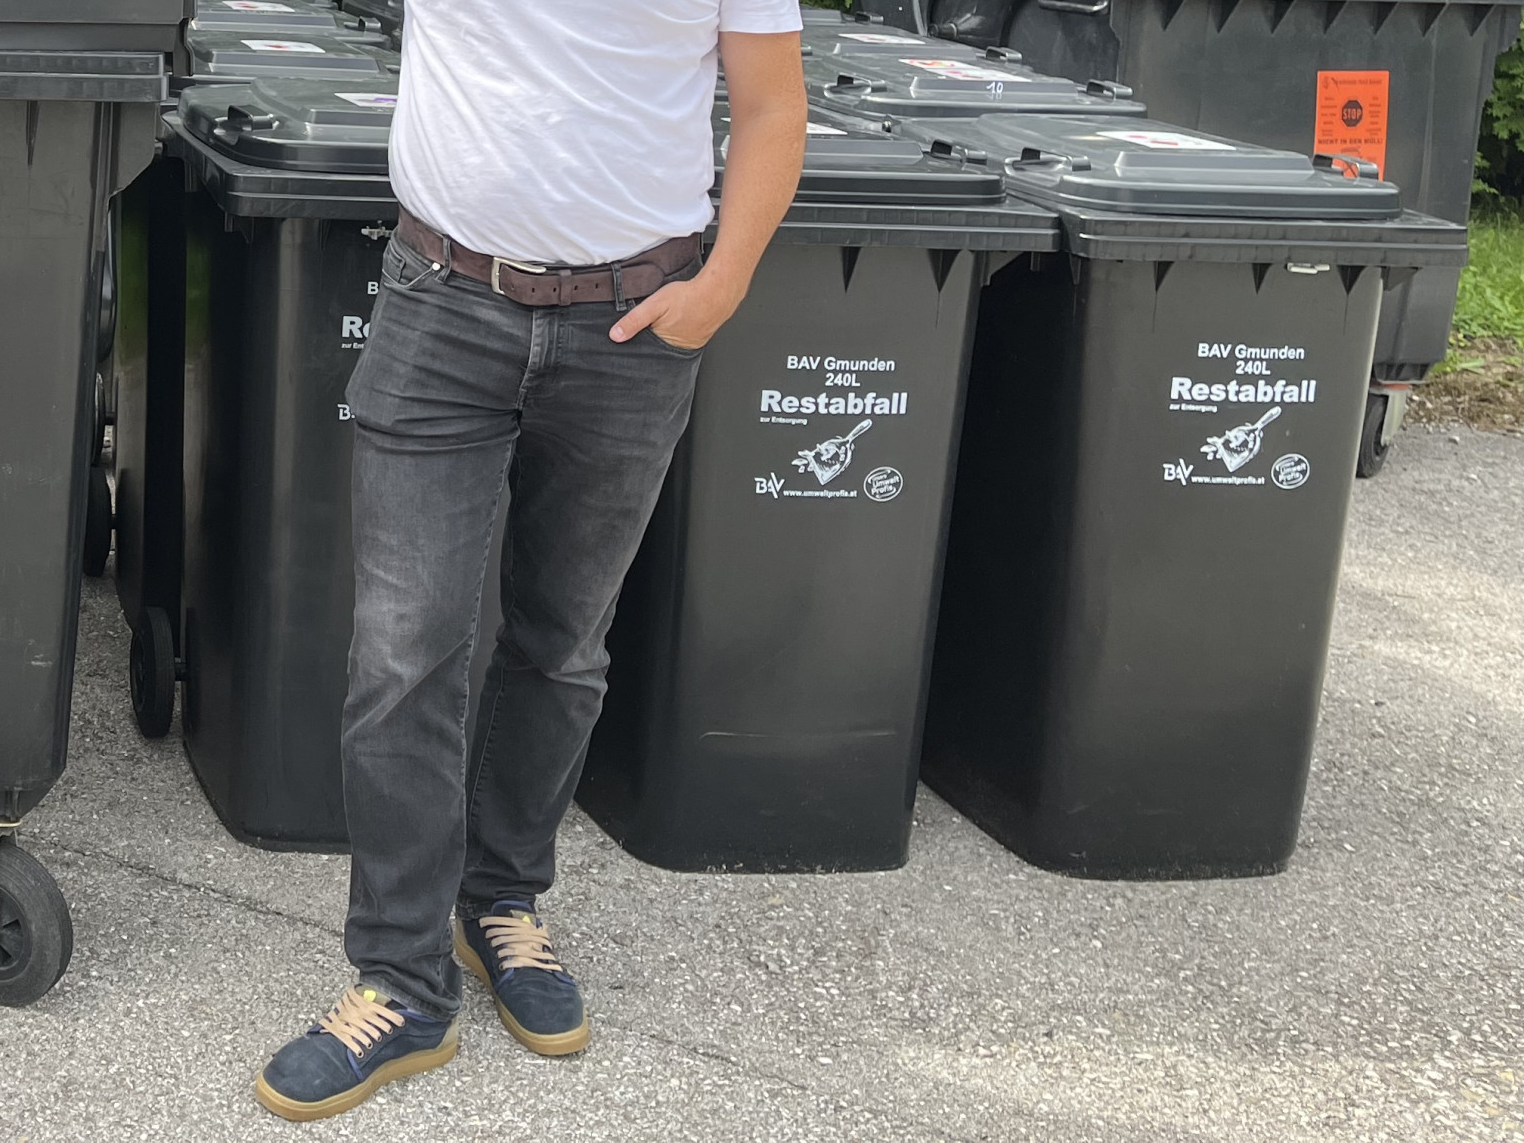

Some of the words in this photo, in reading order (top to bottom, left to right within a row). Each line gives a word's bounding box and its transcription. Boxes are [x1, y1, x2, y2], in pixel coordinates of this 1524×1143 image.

[1342, 108, 1362, 120] STOP
[1197, 343, 1232, 358] BAV
[1234, 344, 1305, 359] Gmunden
[786, 355, 821, 370] BAV
[823, 356, 896, 372] Gmunden
[1235, 360, 1271, 375] 240L
[824, 373, 861, 387] 240L
[1170, 376, 1317, 403] Restabfall
[760, 389, 908, 415] Restabfall
[1162, 457, 1194, 486] BAV
[754, 472, 786, 499] BAV
